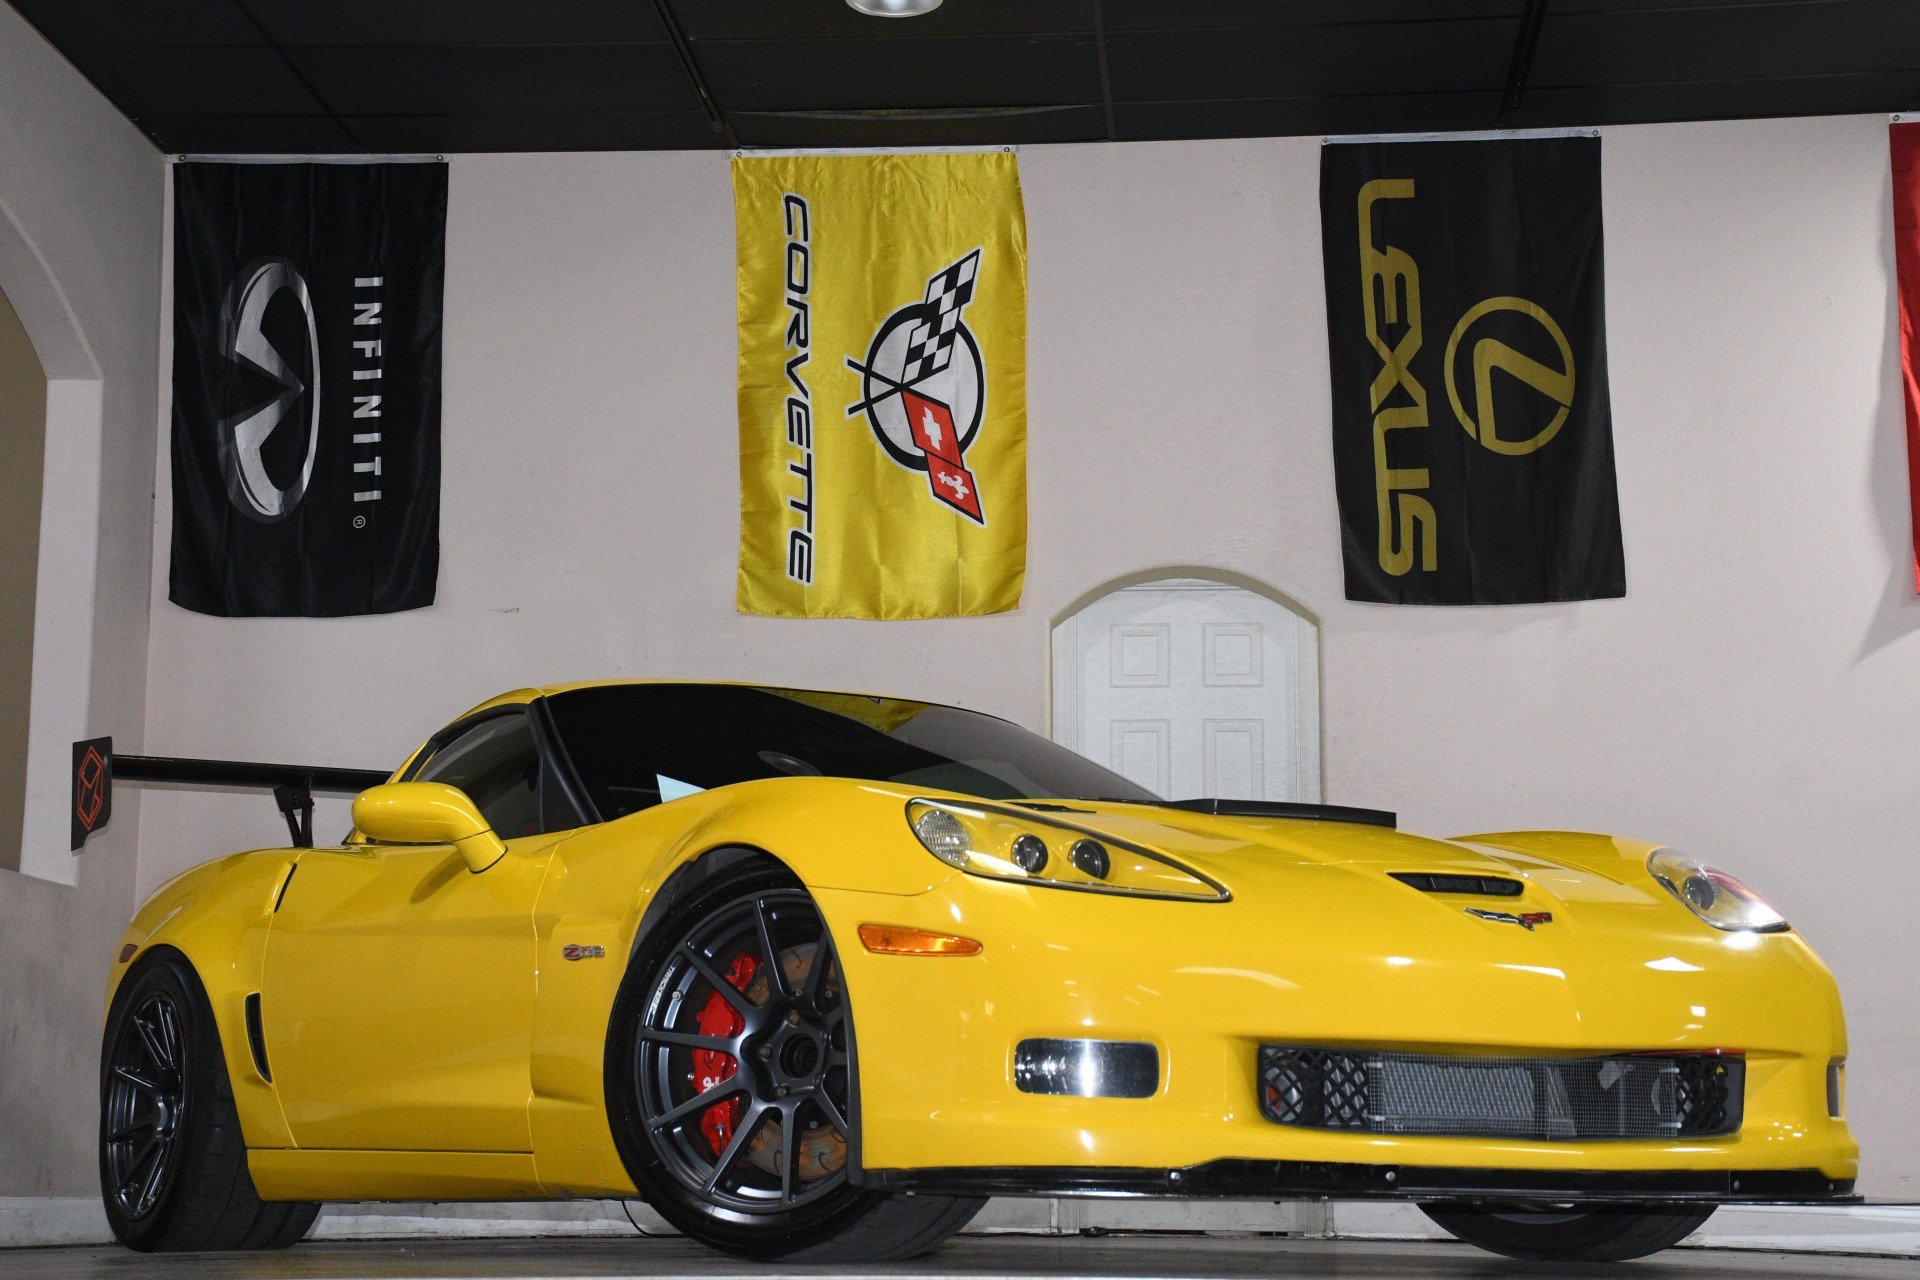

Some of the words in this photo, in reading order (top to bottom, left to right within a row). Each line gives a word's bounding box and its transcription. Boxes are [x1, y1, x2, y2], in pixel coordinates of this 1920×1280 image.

[353, 276, 384, 502] INFINITI
[783, 192, 815, 584] CORVETTE
[1358, 179, 1437, 576] LEXUS
